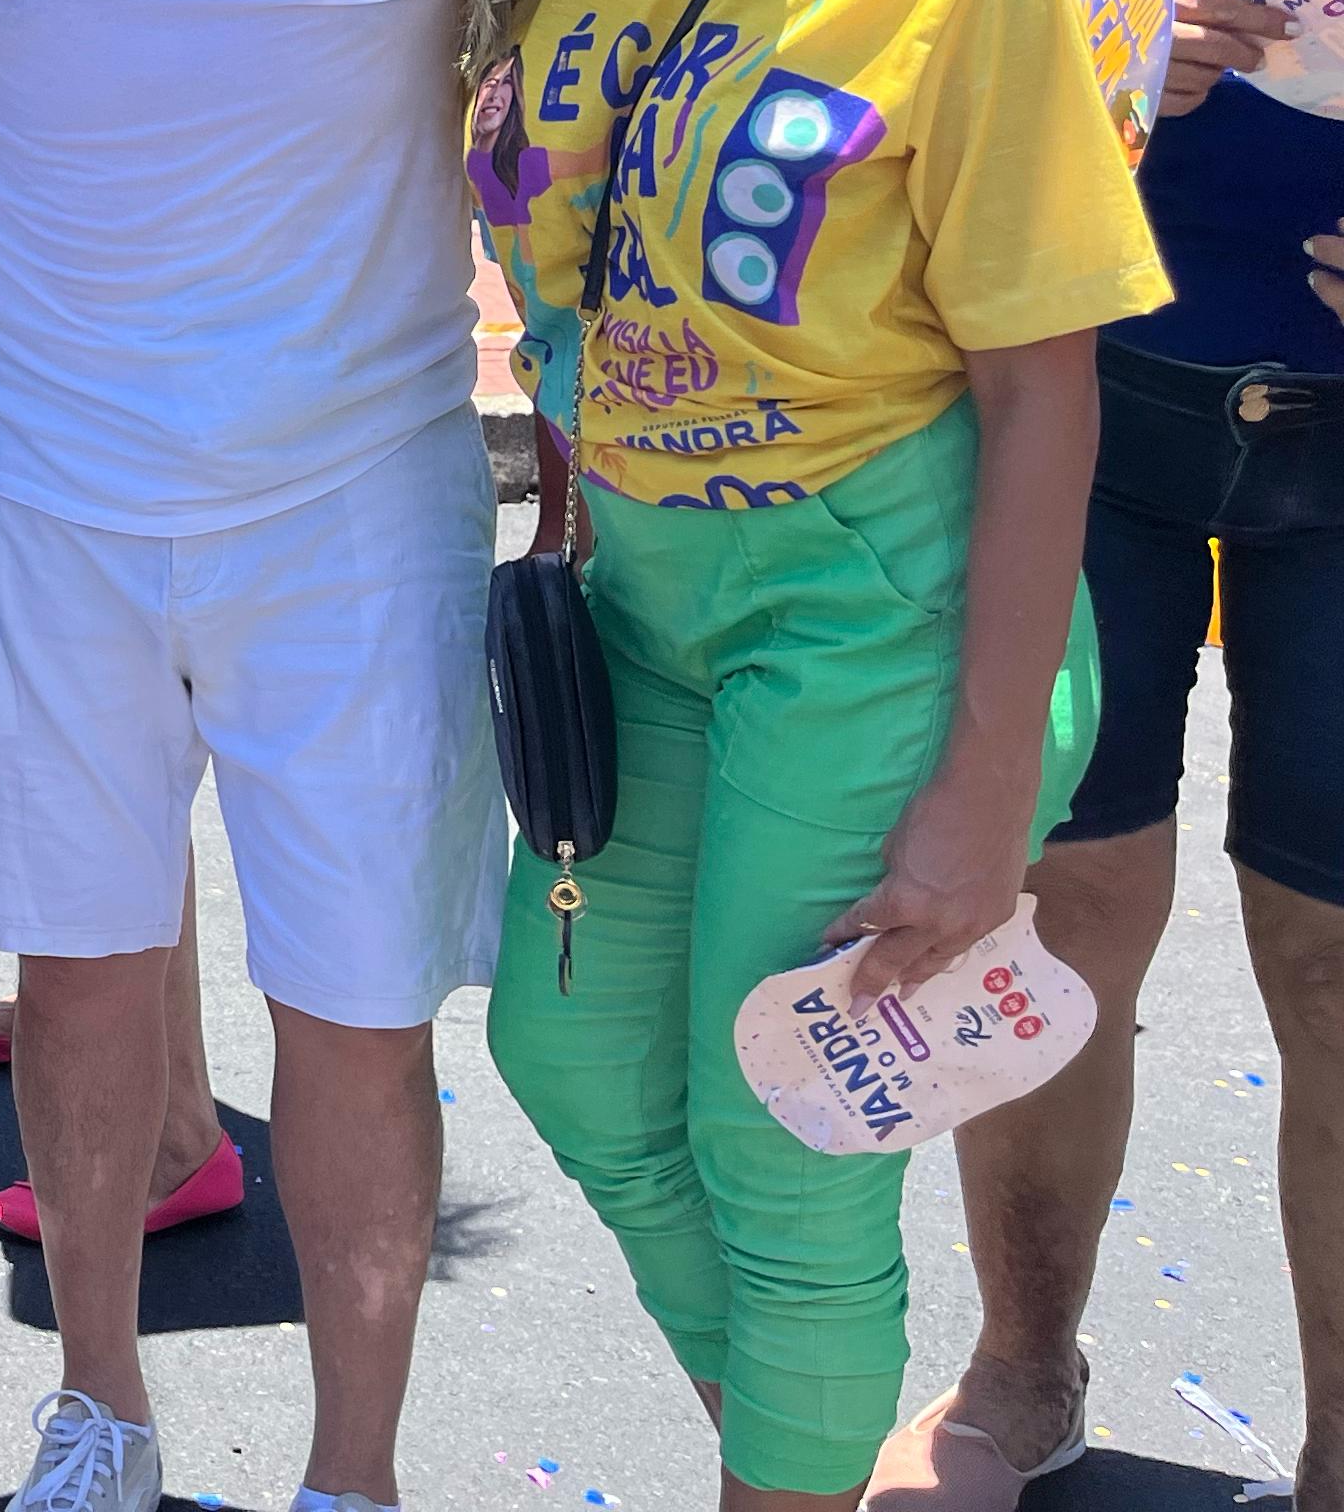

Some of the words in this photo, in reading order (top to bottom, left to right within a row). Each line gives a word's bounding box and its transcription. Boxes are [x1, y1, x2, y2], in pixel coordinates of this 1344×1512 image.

[538, 11, 598, 122] É
[664, 353, 720, 395] EU
[790, 985, 914, 1144] YANDRA
[854, 1012, 914, 1093] MOUR
